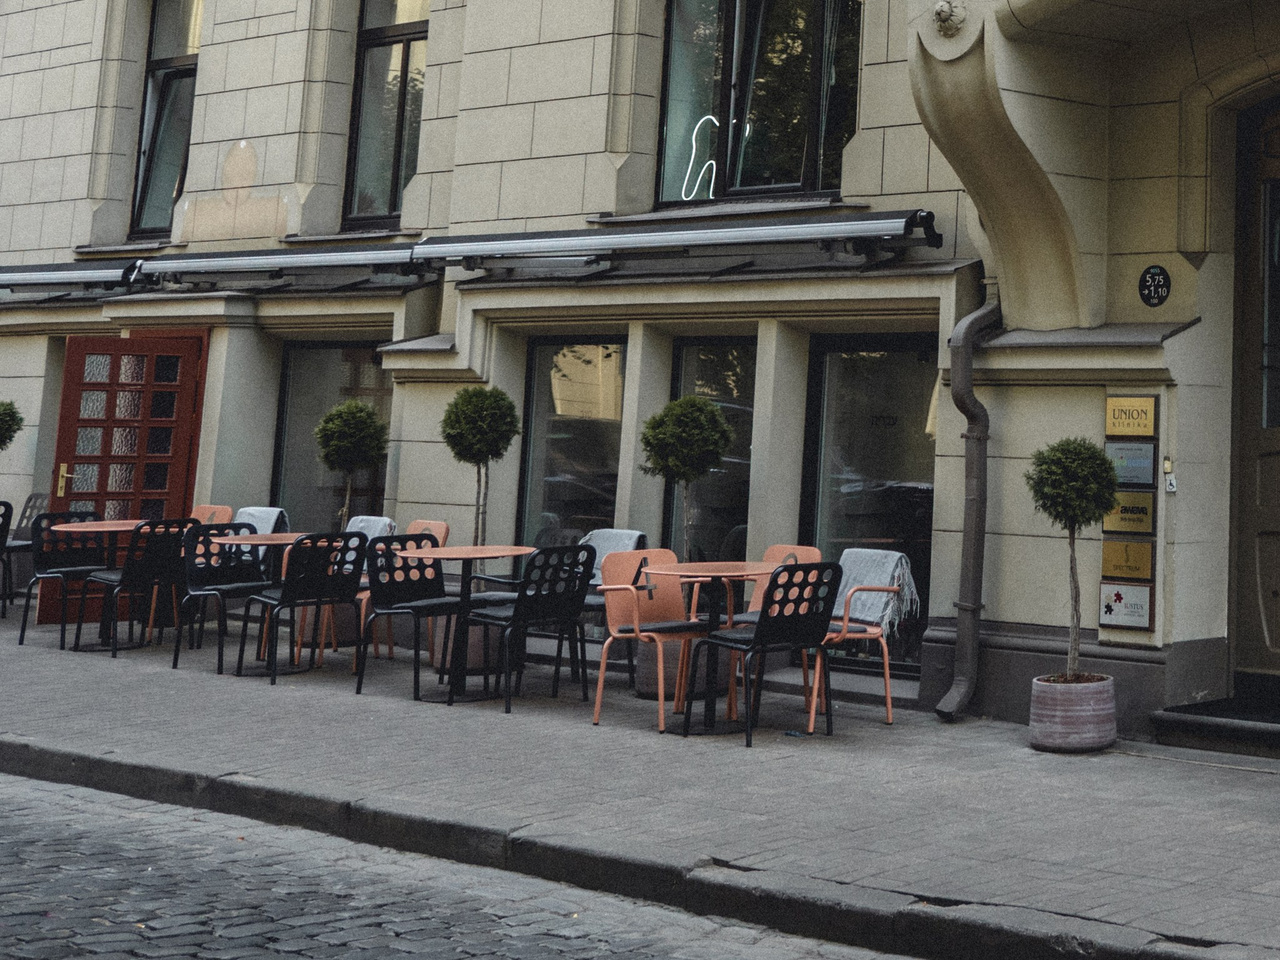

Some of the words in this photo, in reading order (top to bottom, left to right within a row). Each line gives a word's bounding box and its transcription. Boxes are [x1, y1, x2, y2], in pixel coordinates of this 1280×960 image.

[1146, 274, 1164, 286] 5,75
[1150, 286, 1167, 297] 1,10
[1112, 408, 1148, 420] UNION
